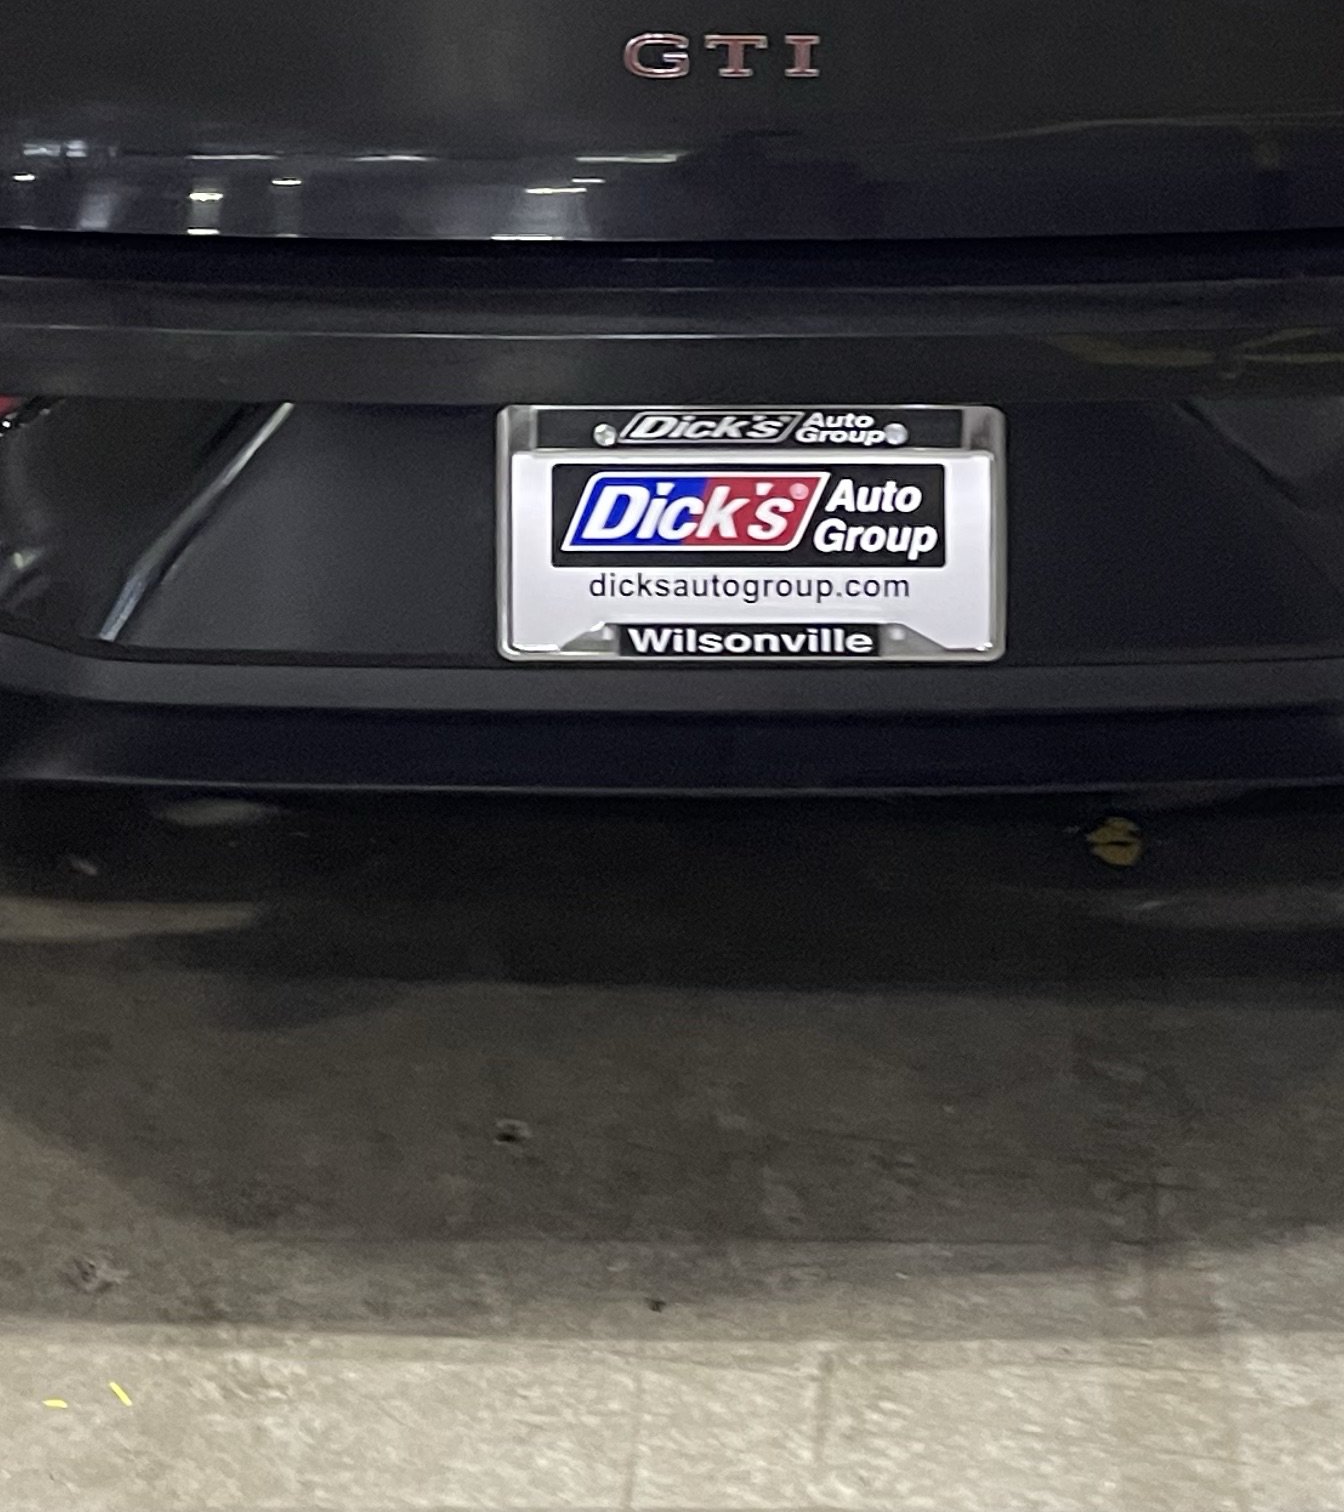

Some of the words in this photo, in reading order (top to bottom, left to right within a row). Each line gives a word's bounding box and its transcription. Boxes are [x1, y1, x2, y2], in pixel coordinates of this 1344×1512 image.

[623, 33, 821, 79] GTI
[629, 415, 786, 440] Dick's
[795, 427, 887, 446] Group
[802, 412, 876, 429] Auto
[581, 481, 796, 541] Dick's
[825, 479, 922, 513] Auto
[813, 520, 938, 560] Group
[589, 573, 911, 605] dicksautogroup.com
[628, 627, 874, 655] Wilsonville
